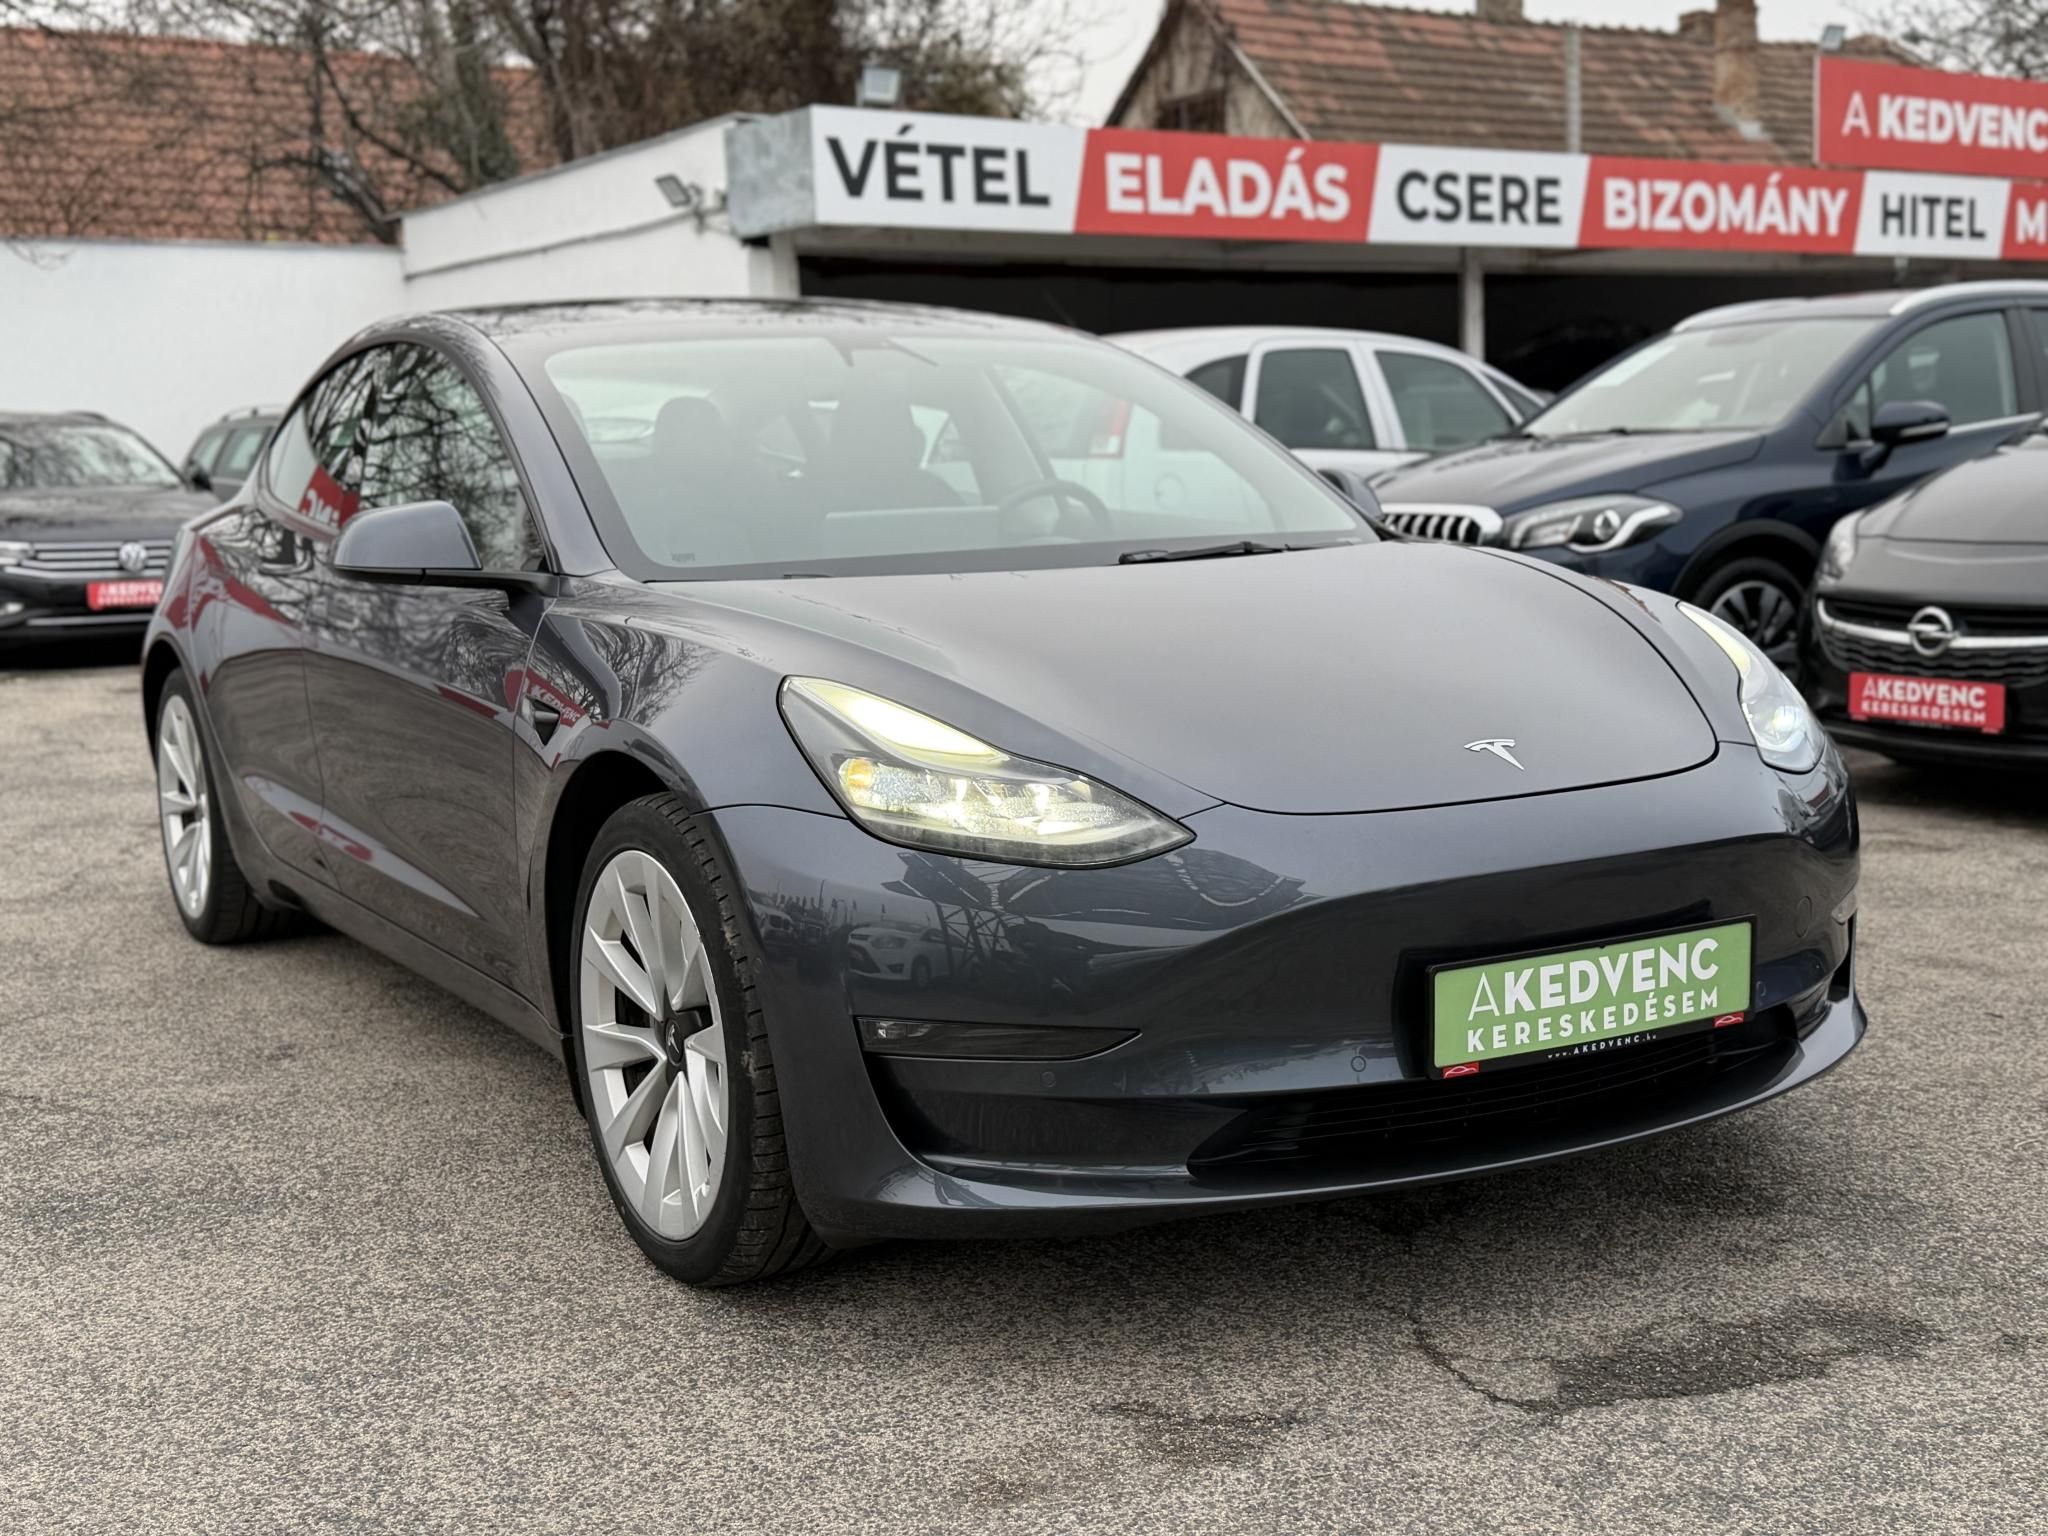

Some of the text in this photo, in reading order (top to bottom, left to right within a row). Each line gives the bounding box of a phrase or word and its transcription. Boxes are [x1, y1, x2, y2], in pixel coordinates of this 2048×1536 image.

[1841, 91, 2048, 153] A KEDVENC
[827, 125, 1051, 207] VÉTEL
[1105, 147, 1351, 222] ELADÁS
[1396, 169, 1562, 225] CSERE
[1603, 166, 1848, 240] BIZOMÁNY
[1881, 193, 1986, 239] HITEL
[1467, 987, 1718, 1053] KERESKEDÉSEM
